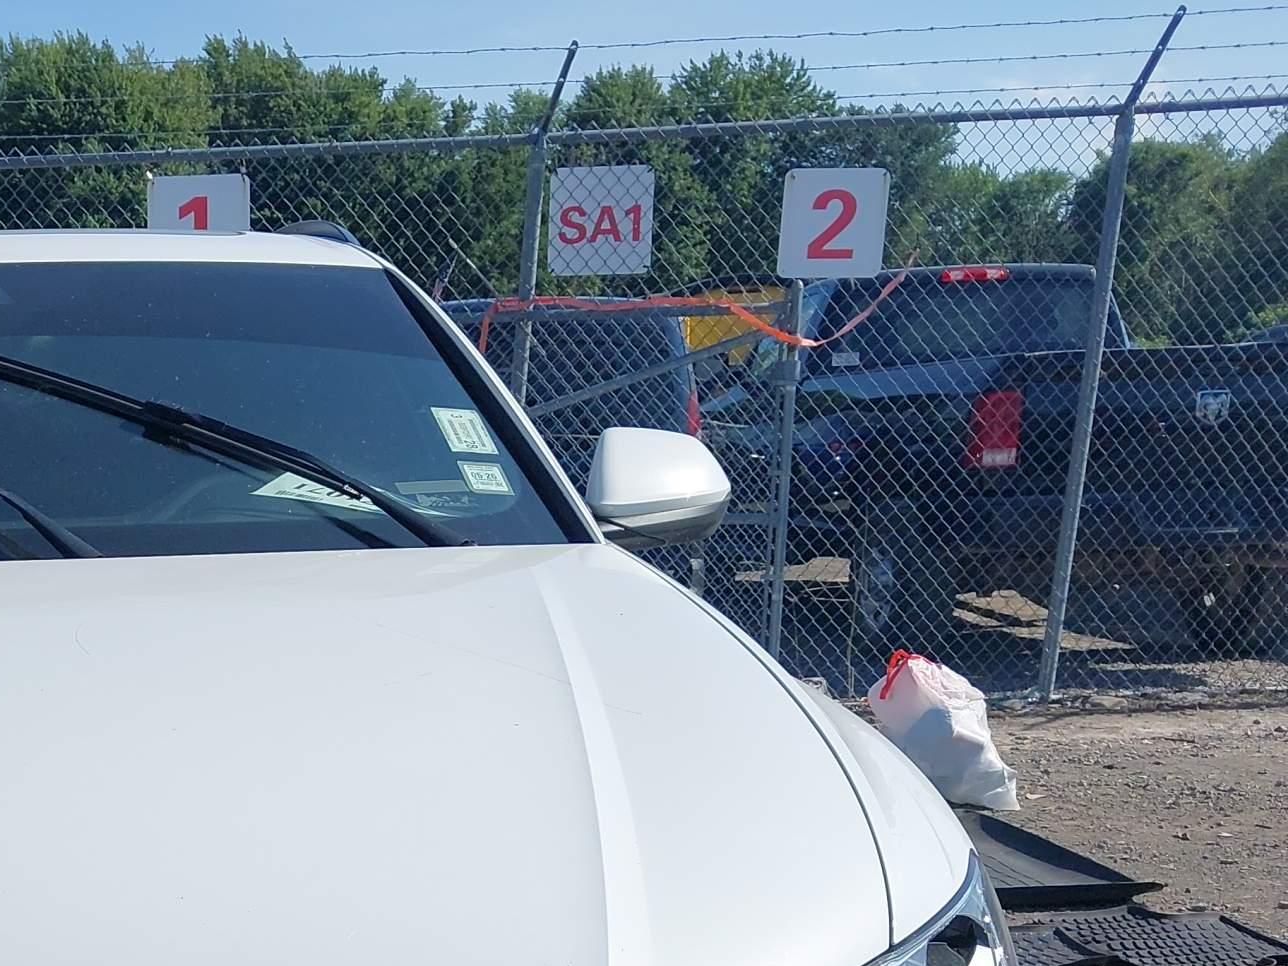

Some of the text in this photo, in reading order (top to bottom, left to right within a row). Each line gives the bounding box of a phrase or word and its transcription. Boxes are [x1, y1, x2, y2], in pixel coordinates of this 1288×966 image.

[178, 196, 208, 230] 1
[558, 204, 643, 244] SA1
[806, 188, 858, 260] 2
